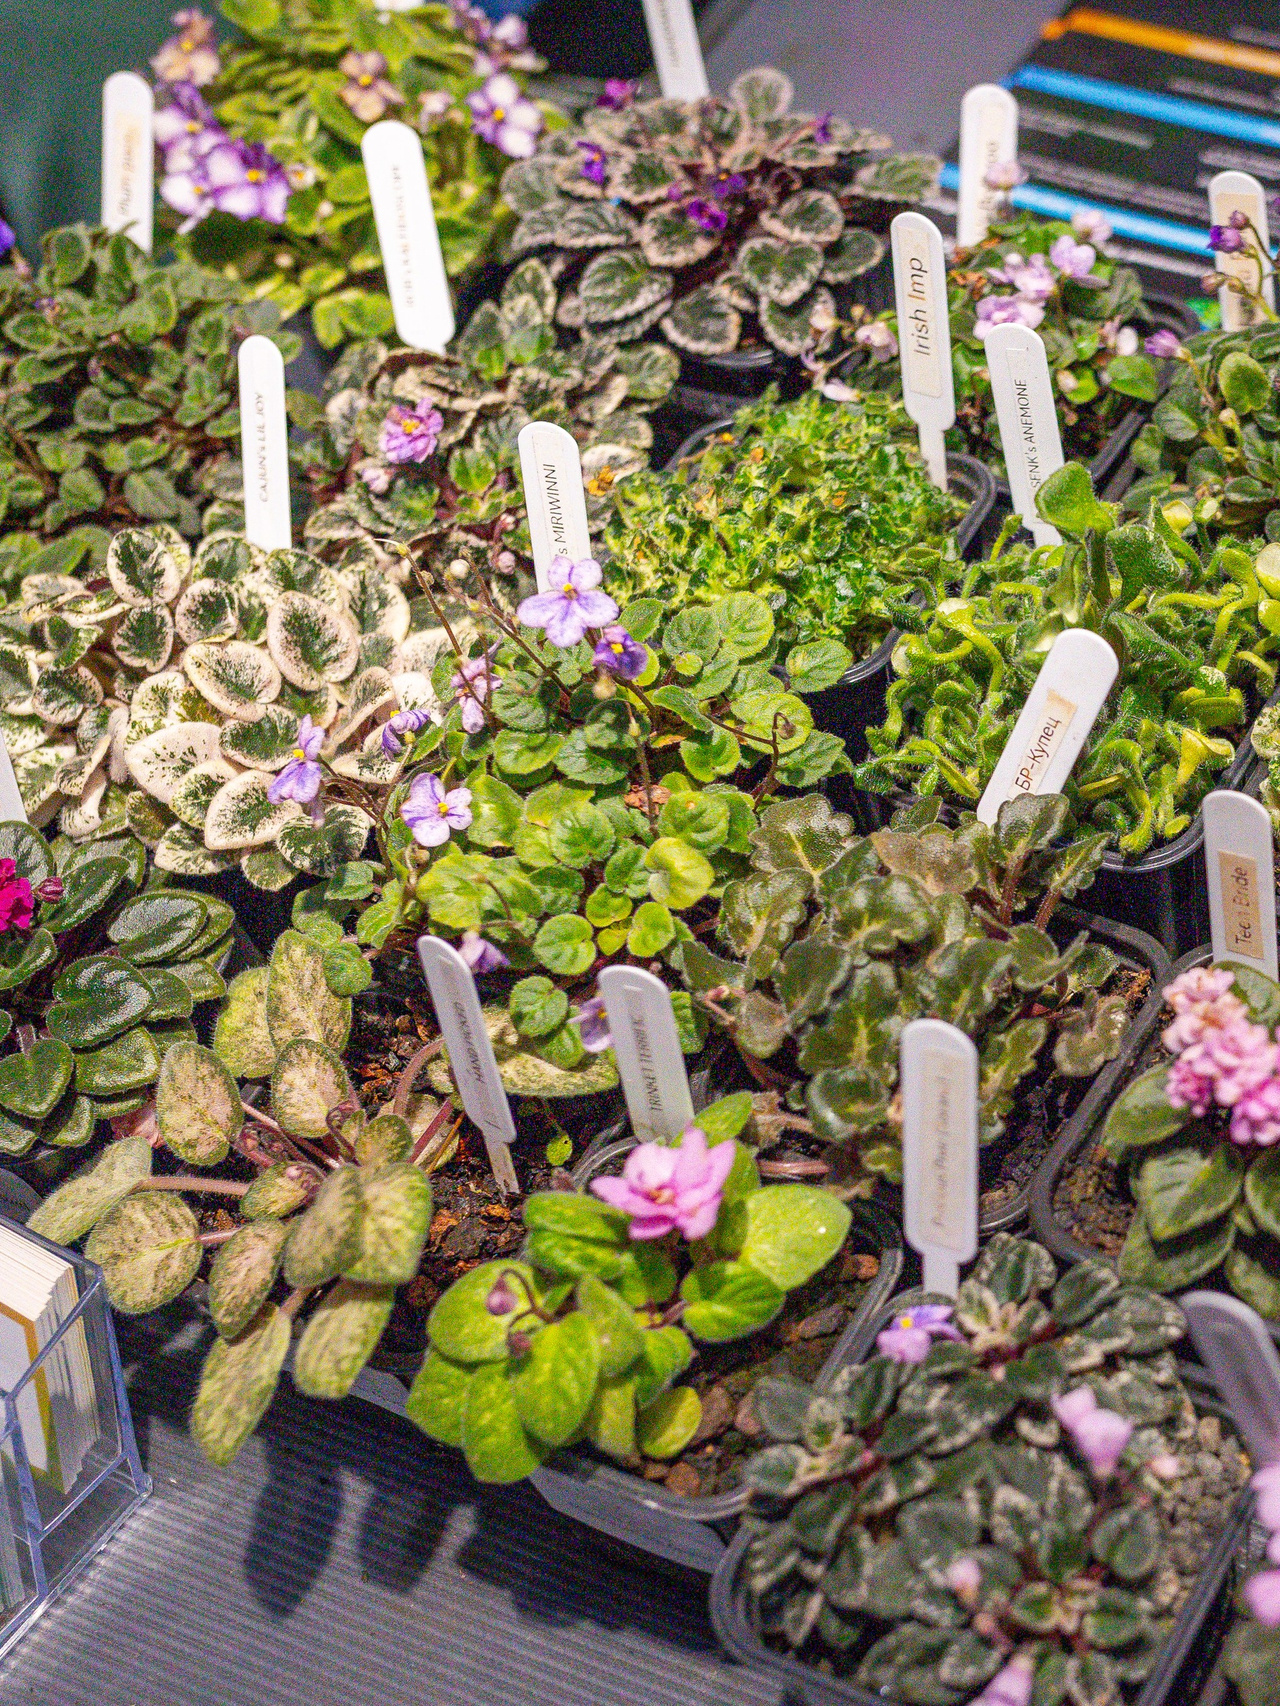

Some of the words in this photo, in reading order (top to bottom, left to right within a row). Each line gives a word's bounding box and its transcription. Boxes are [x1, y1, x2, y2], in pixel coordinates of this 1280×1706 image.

[907, 256, 926, 302] Imp
[907, 307, 930, 356] Irish
[1014, 378, 1036, 444] ANEMONE
[542, 460, 566, 544] MIRIWINNI
[1014, 713, 1064, 791] БР-Купец
